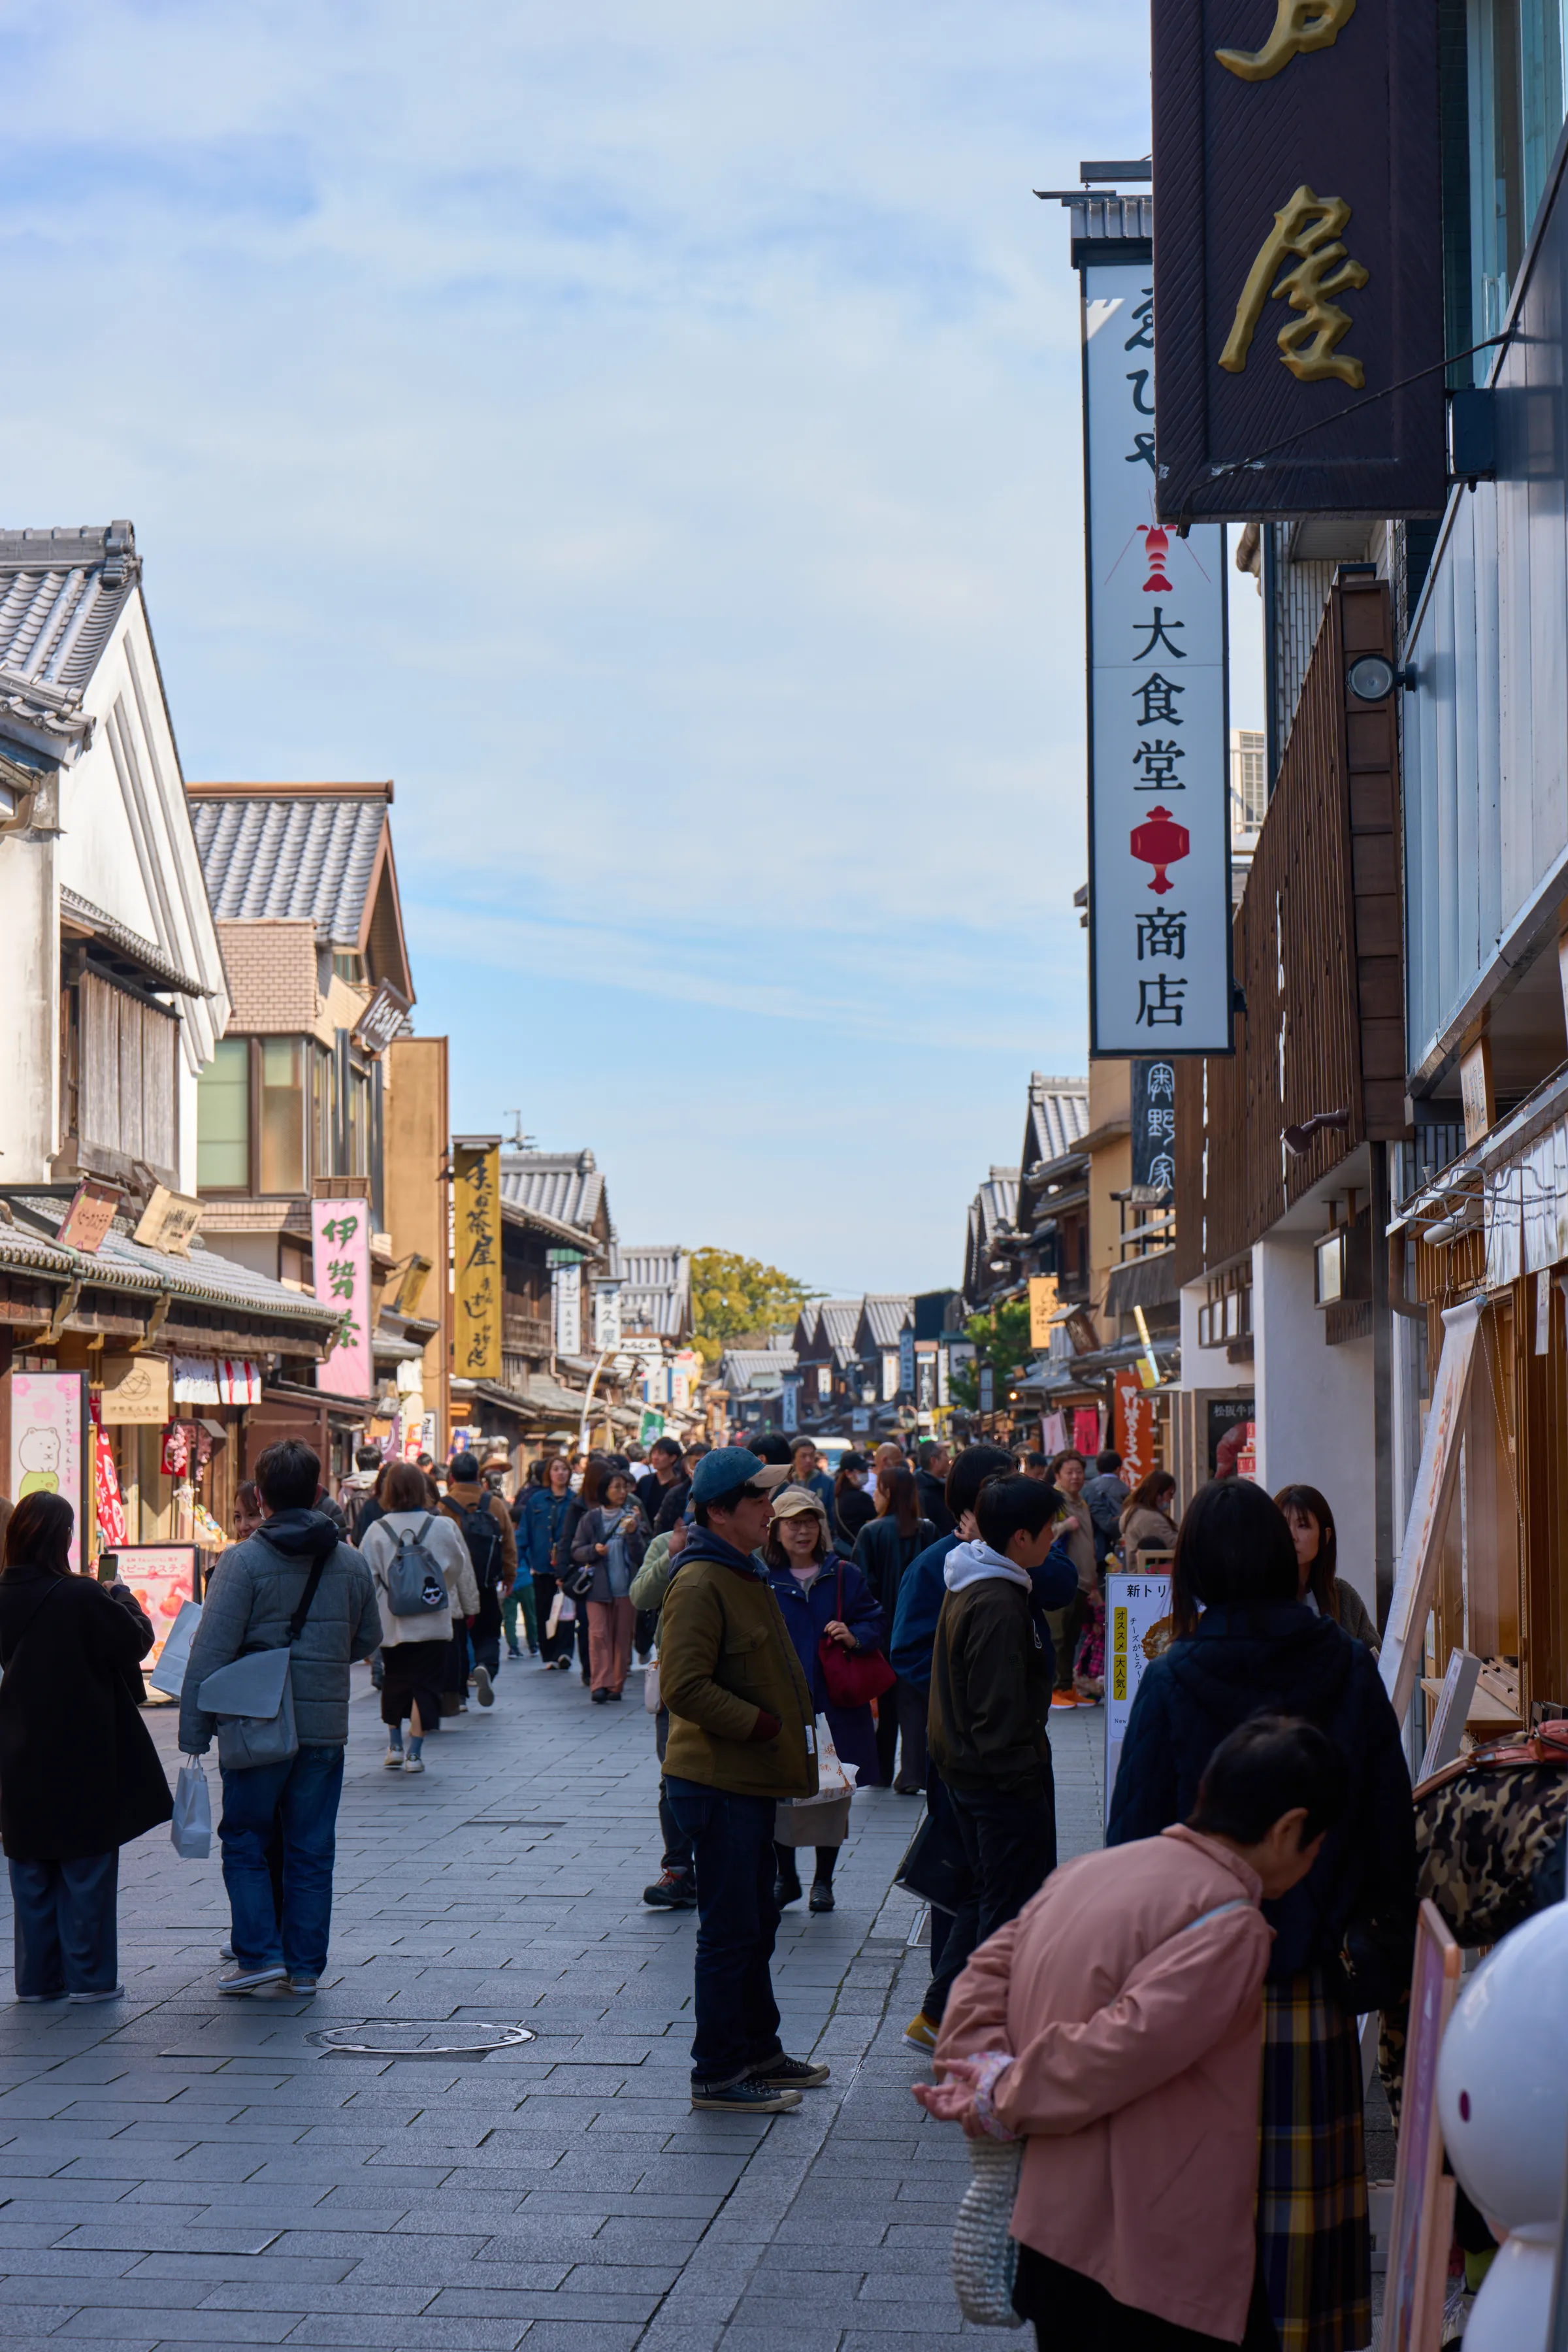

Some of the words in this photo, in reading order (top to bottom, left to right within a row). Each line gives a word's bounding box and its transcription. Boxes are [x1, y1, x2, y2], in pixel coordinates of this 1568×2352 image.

[1132, 606, 1188, 791] 大食堂
[1135, 906, 1189, 1028] 商店
[1117, 1610, 1126, 1651] オススメ
[1115, 1658, 1126, 1699] 大人気!
